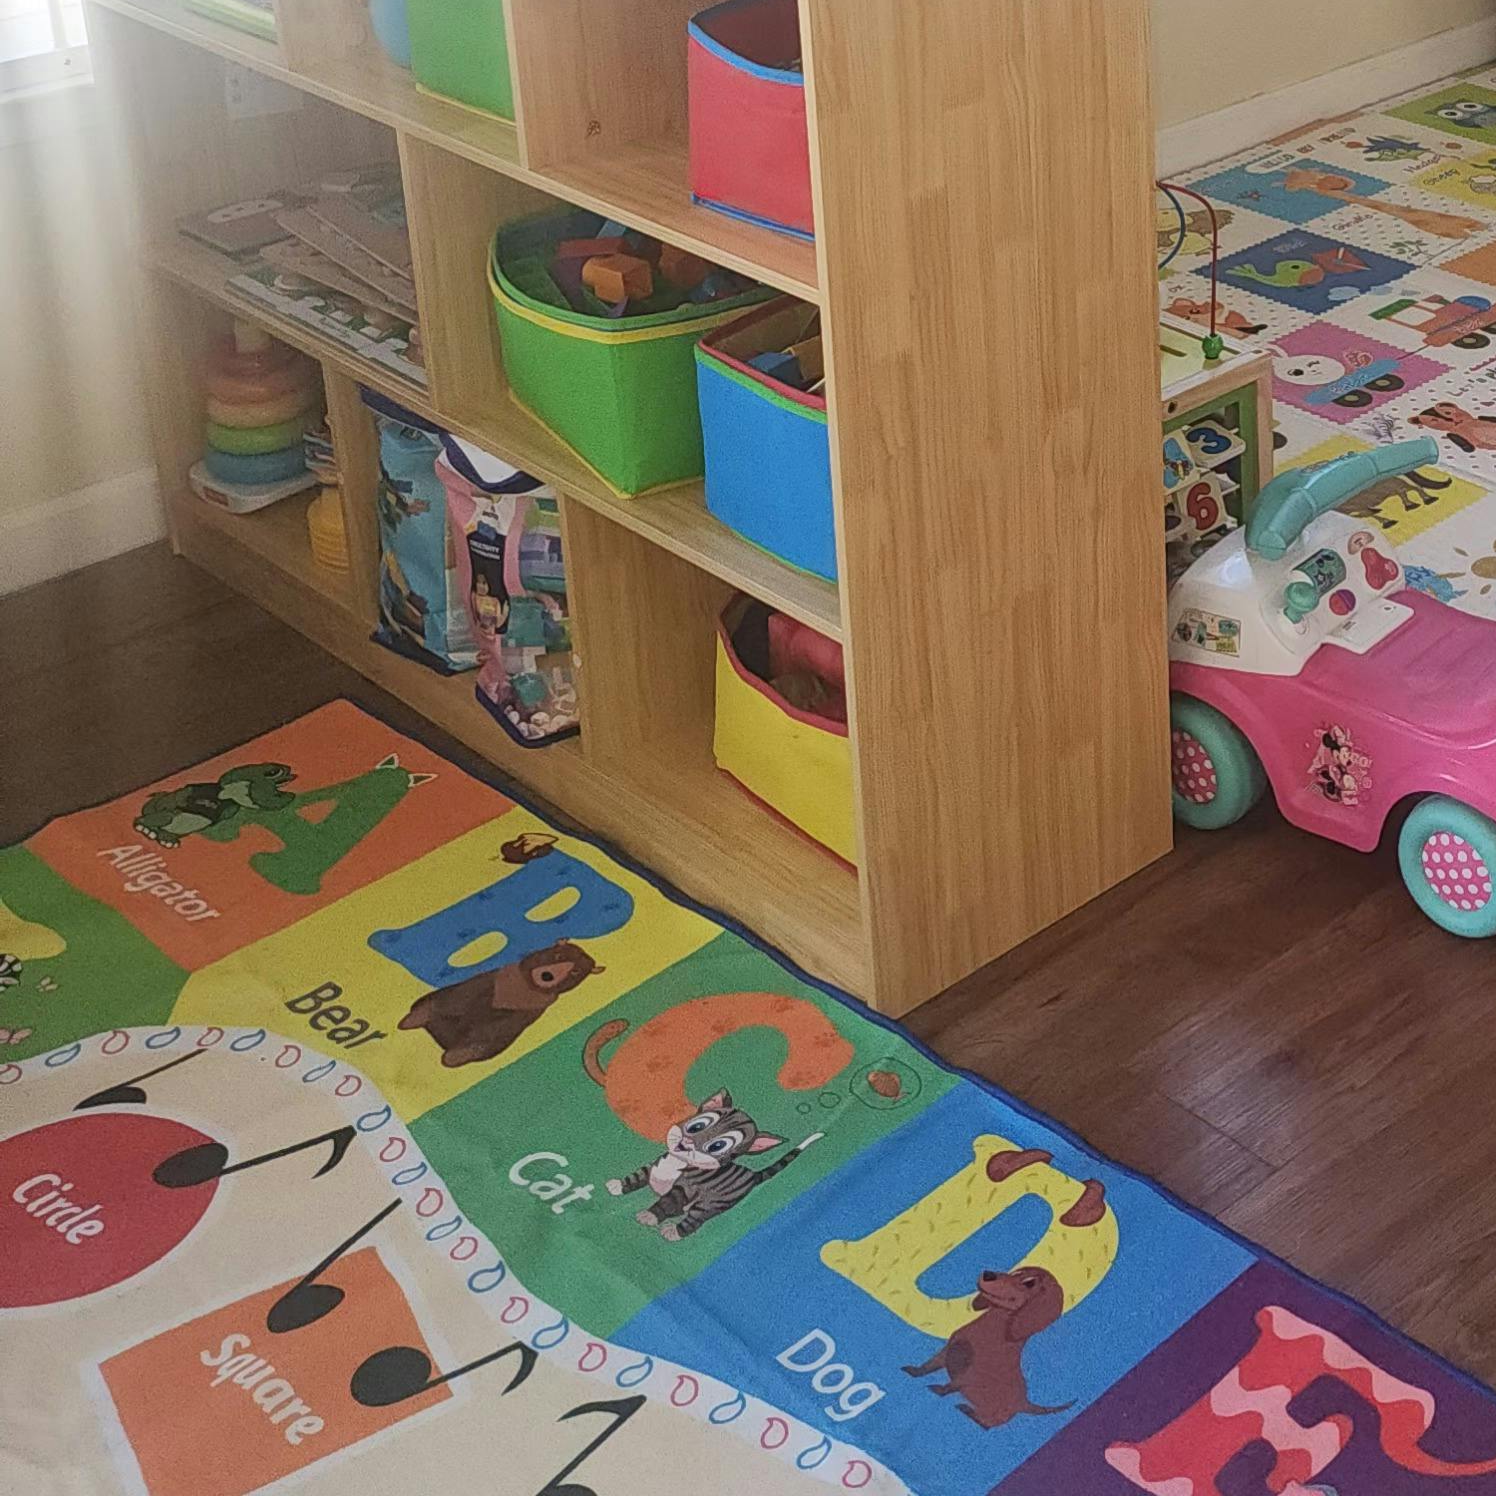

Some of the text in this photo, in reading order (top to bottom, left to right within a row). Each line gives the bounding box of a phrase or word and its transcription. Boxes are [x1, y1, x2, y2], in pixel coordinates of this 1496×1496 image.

[1185, 427, 1232, 455] 3
[1186, 481, 1219, 531] 6
[96, 844, 221, 922] Alligator
[284, 981, 388, 1050] Bear
[12, 1173, 105, 1245] Circle
[506, 1151, 594, 1217] Cat
[200, 1333, 325, 1446] Square
[774, 1328, 887, 1423] Dog
